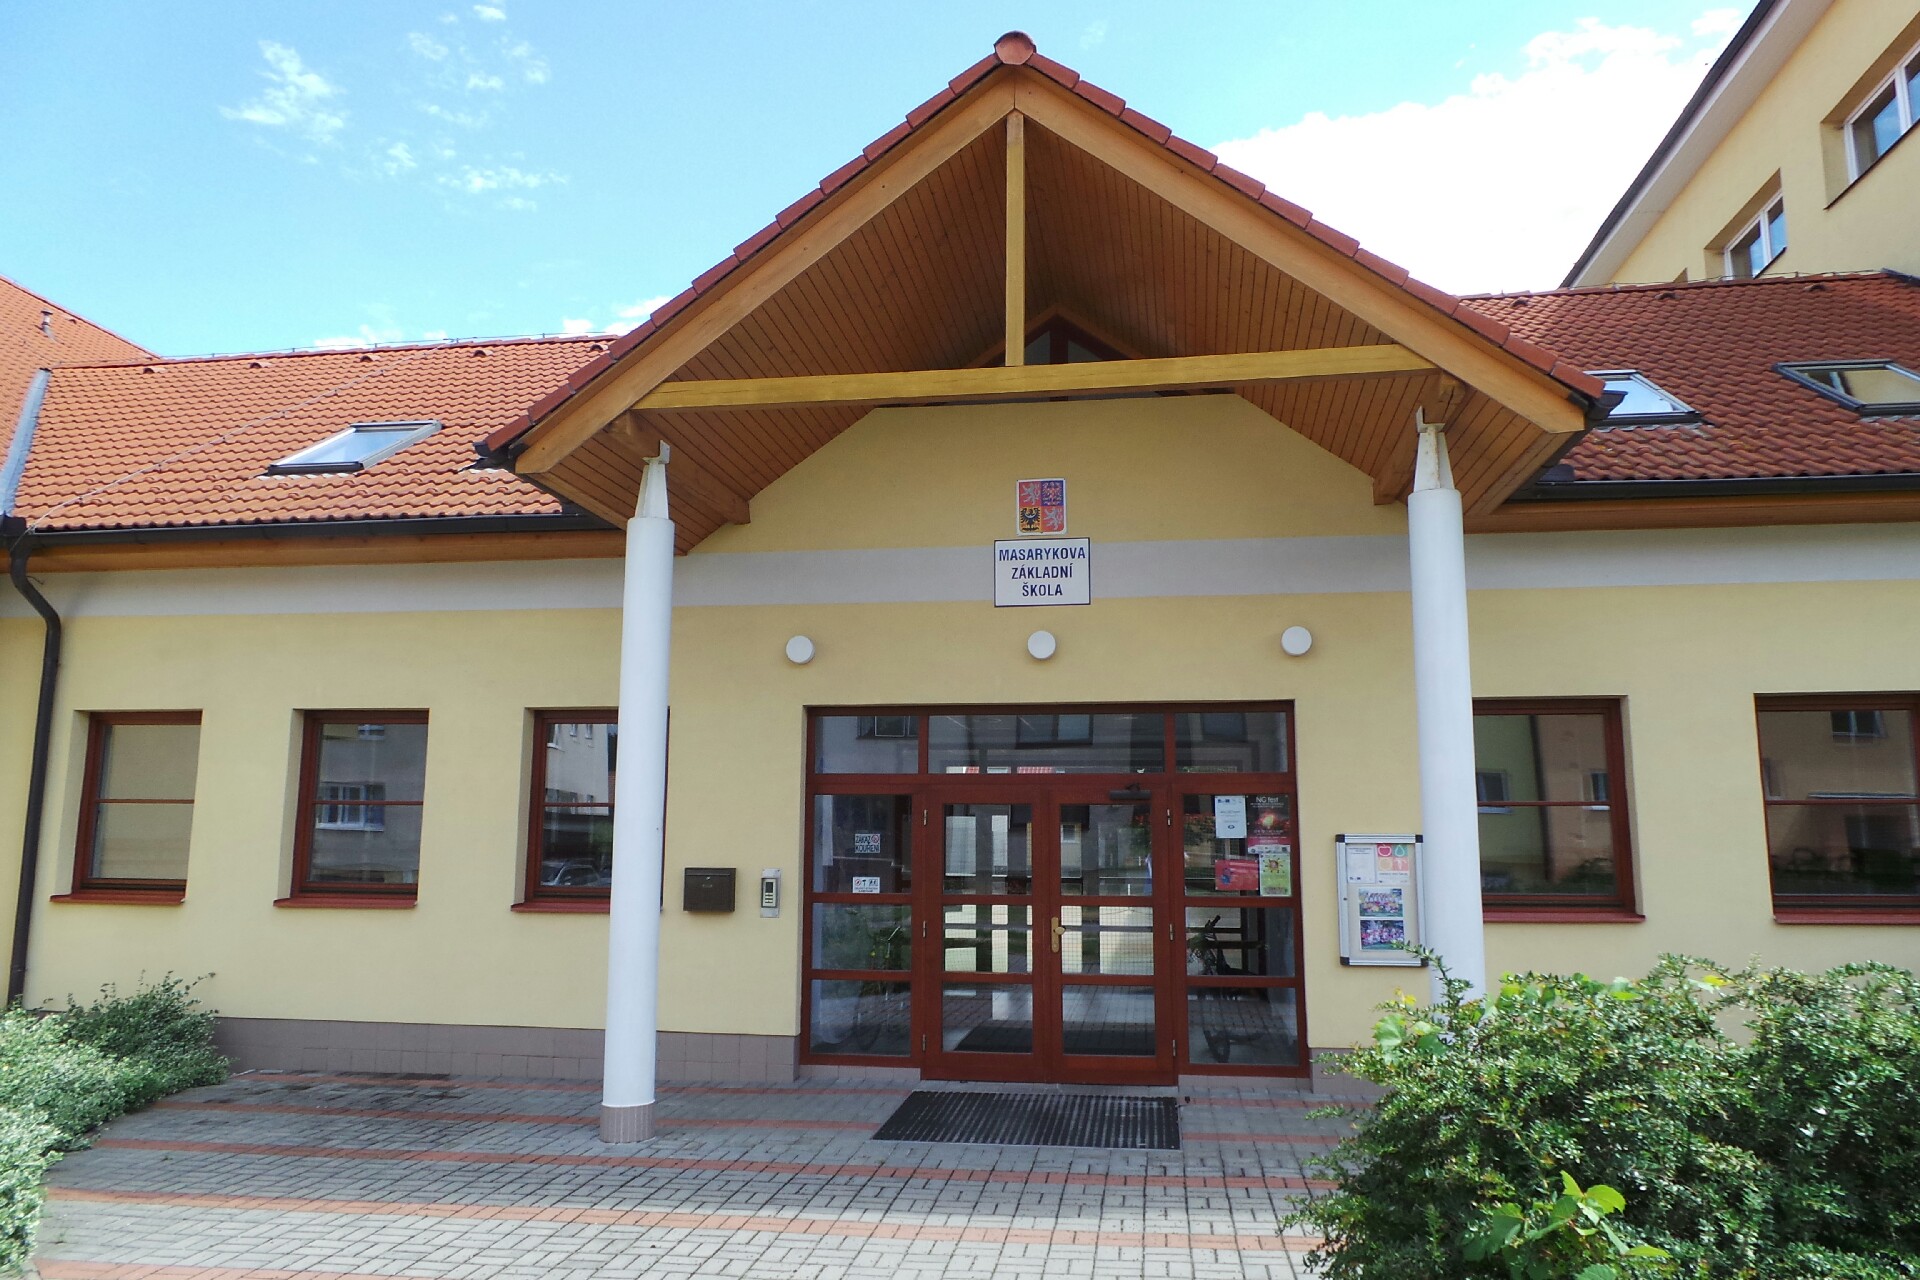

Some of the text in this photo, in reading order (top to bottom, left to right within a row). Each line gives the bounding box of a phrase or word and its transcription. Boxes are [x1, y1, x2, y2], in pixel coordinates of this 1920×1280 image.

[999, 547, 1086, 561] MASARYKOVA
[1011, 562, 1074, 580] ZÁKLADNÍ
[1022, 582, 1063, 596] ŠKOLA
